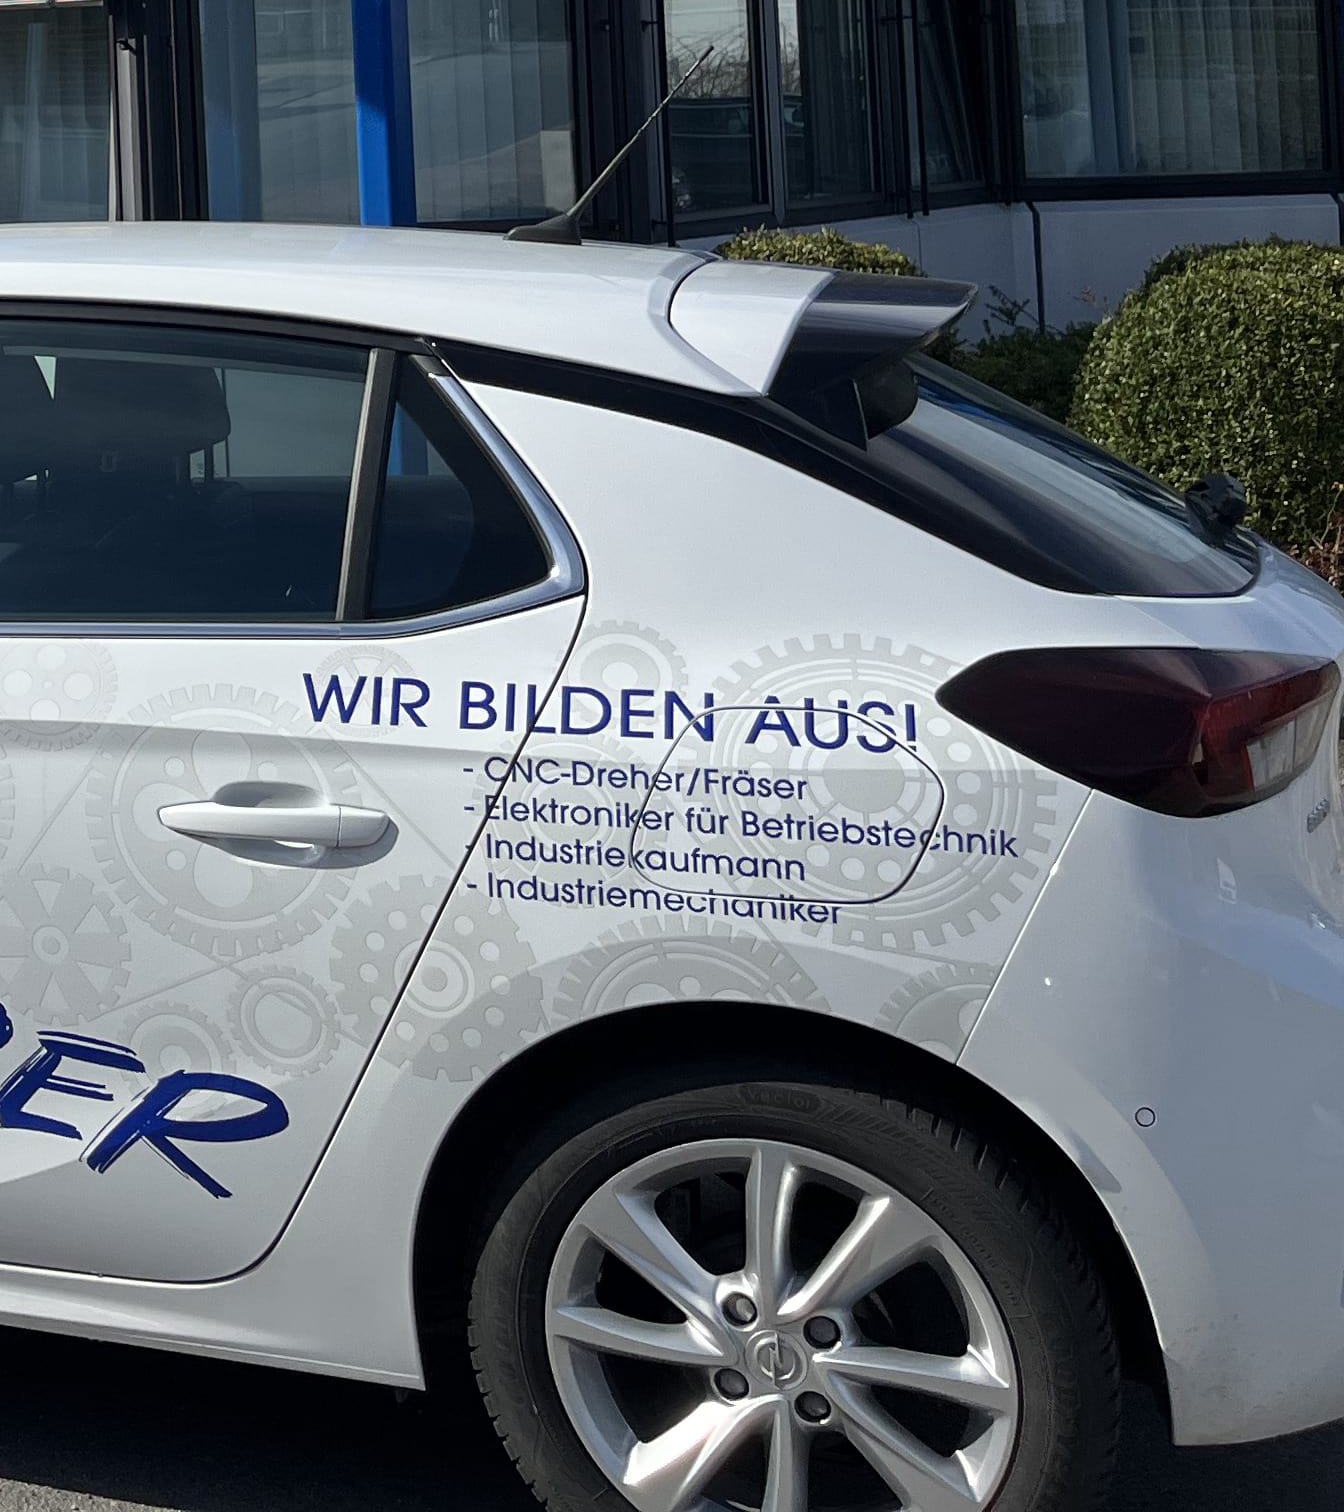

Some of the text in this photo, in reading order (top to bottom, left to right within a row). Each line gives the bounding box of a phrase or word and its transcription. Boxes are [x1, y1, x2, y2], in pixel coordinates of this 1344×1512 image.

[302, 673, 918, 754] WIR BILDEN AUS!
[484, 755, 809, 801] CNC-Dreher/Fräser
[484, 794, 675, 832] Elektroniker
[685, 807, 729, 836] für
[741, 810, 1020, 859] Betriebstechnik
[485, 833, 807, 882] Industriekaufmann
[487, 872, 841, 924] Industriemechaniker
